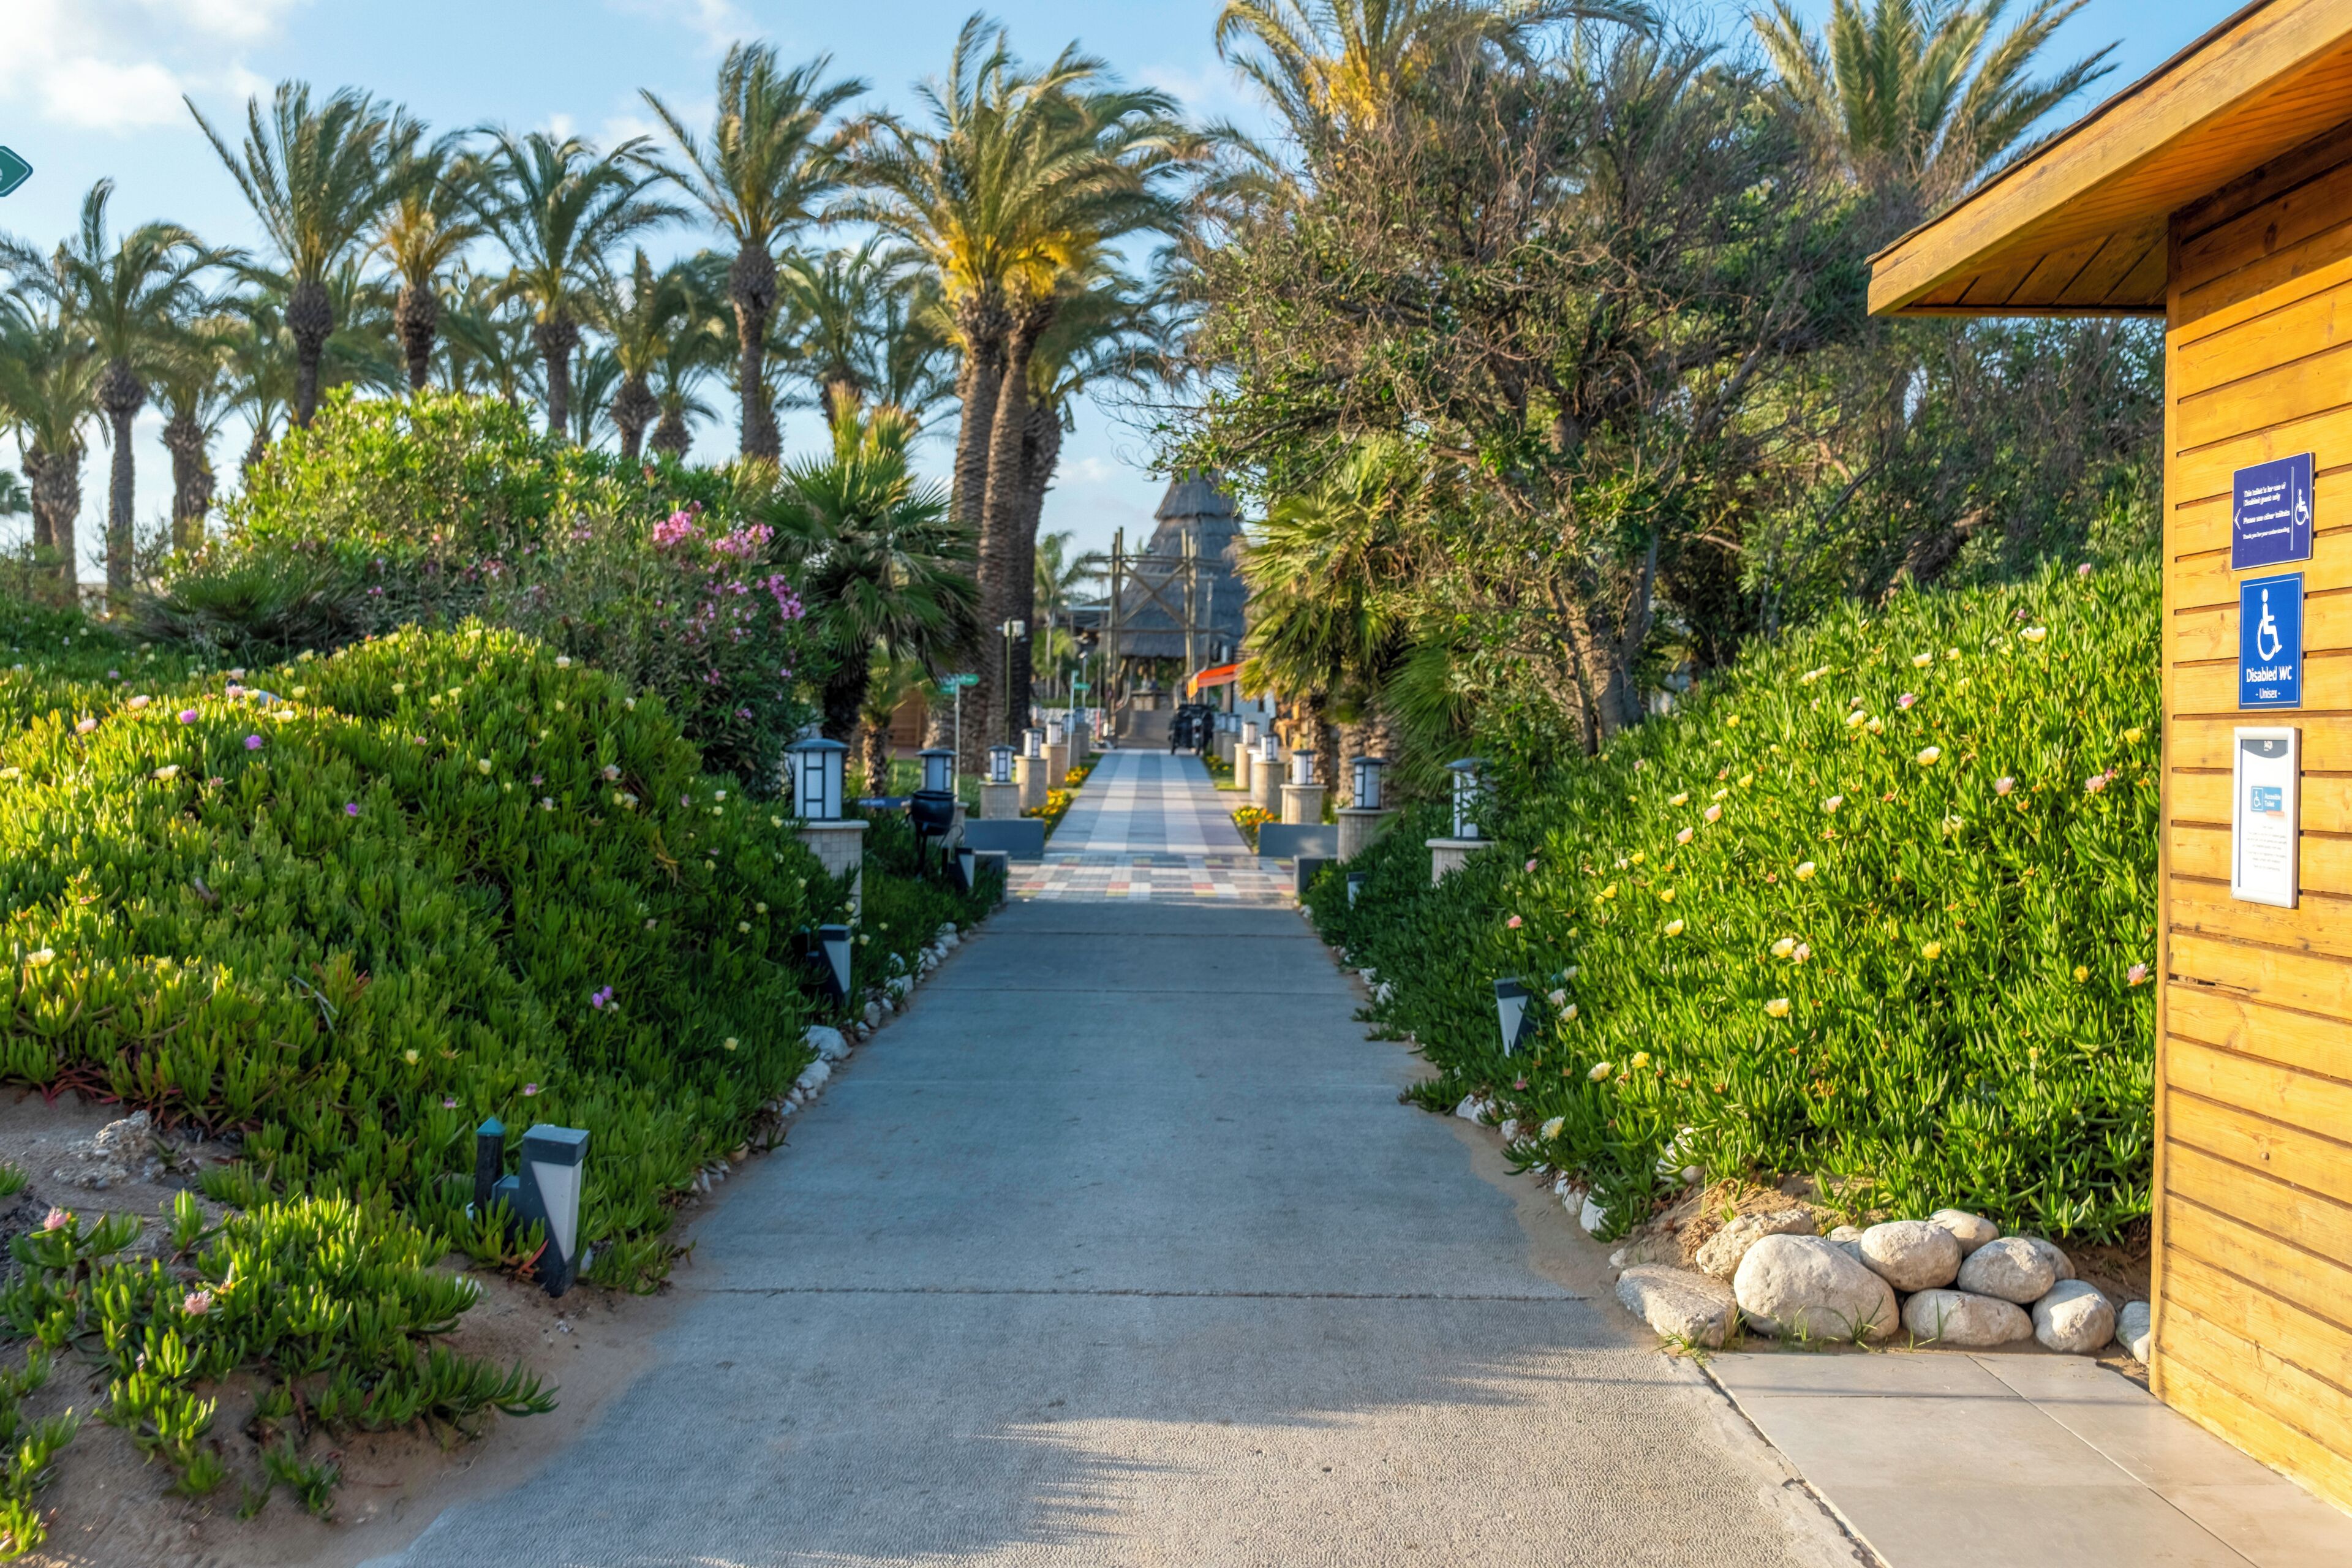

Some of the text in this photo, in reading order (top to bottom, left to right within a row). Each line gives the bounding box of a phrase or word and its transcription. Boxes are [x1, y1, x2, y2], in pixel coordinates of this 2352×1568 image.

[2272, 492, 2281, 502] only
[2246, 665, 2292, 682] Disabled WC
